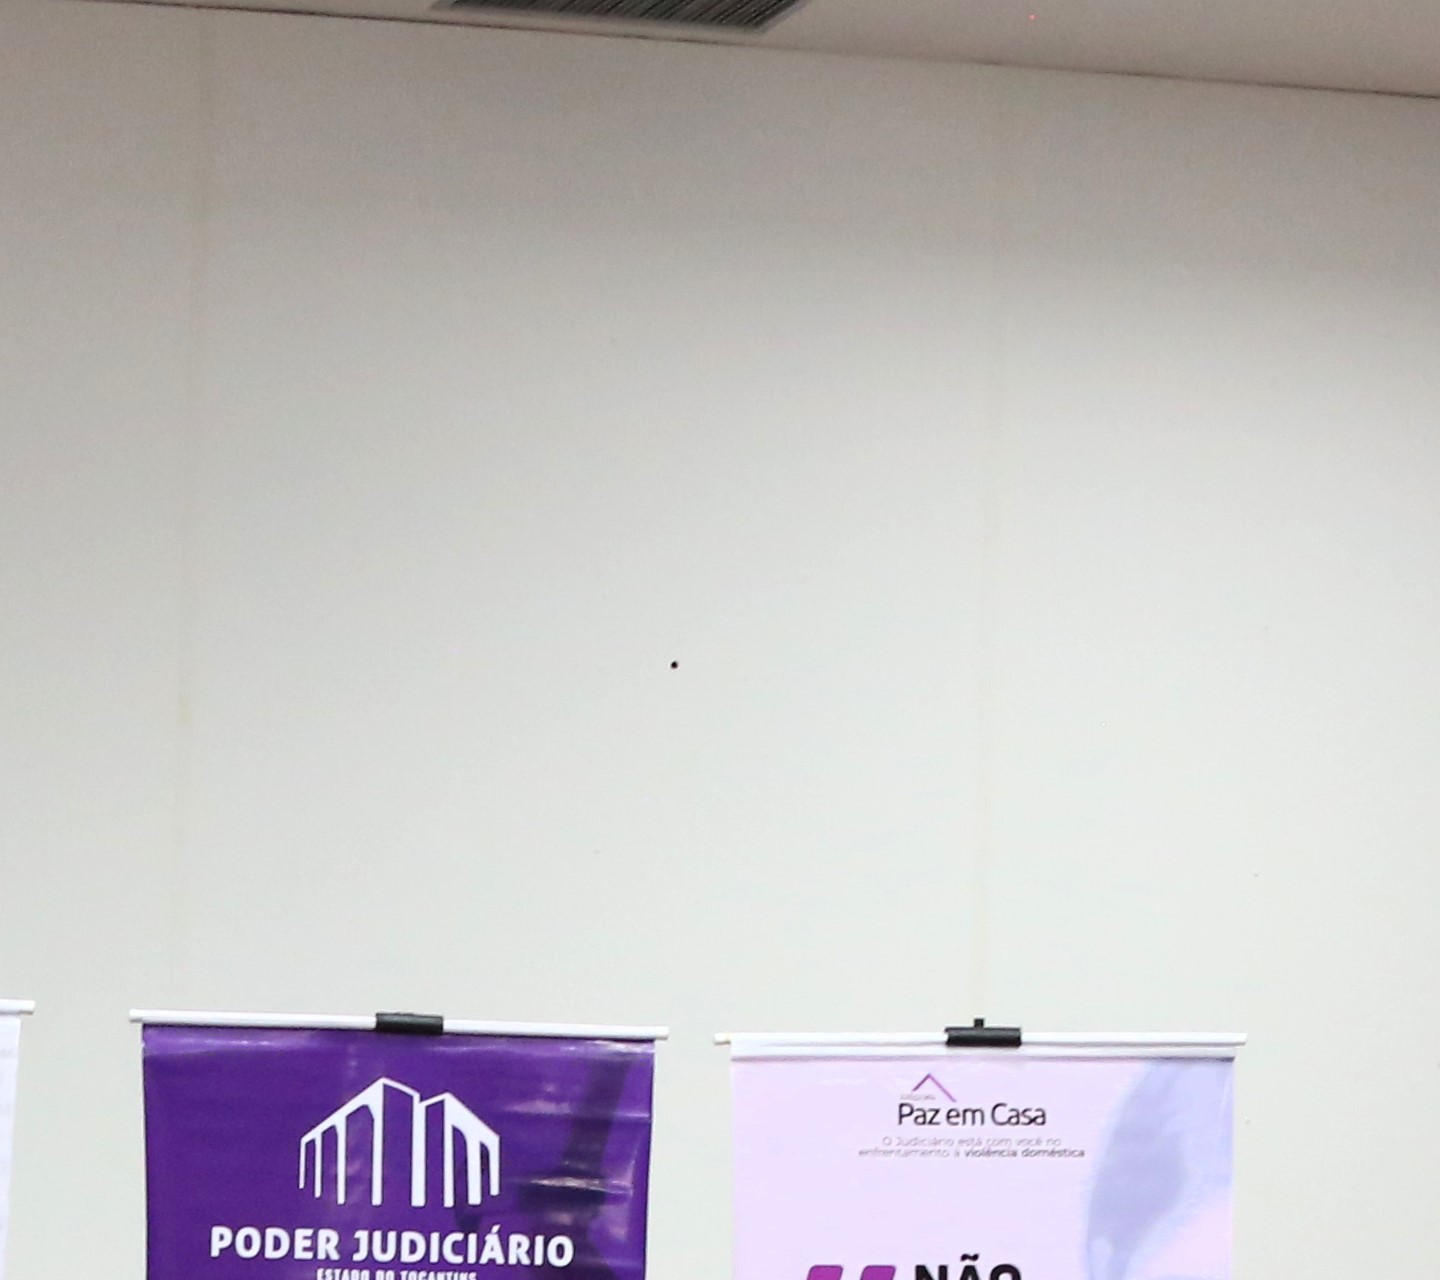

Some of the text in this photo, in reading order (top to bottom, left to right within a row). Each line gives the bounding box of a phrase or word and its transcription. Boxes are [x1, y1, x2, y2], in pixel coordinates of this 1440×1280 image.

[898, 1102, 1047, 1126] Paz em Casa
[965, 1147, 1017, 1158] violência
[1021, 1147, 1085, 1158] doméstica
[210, 1224, 576, 1268] PODER JUDICIÁRIO
